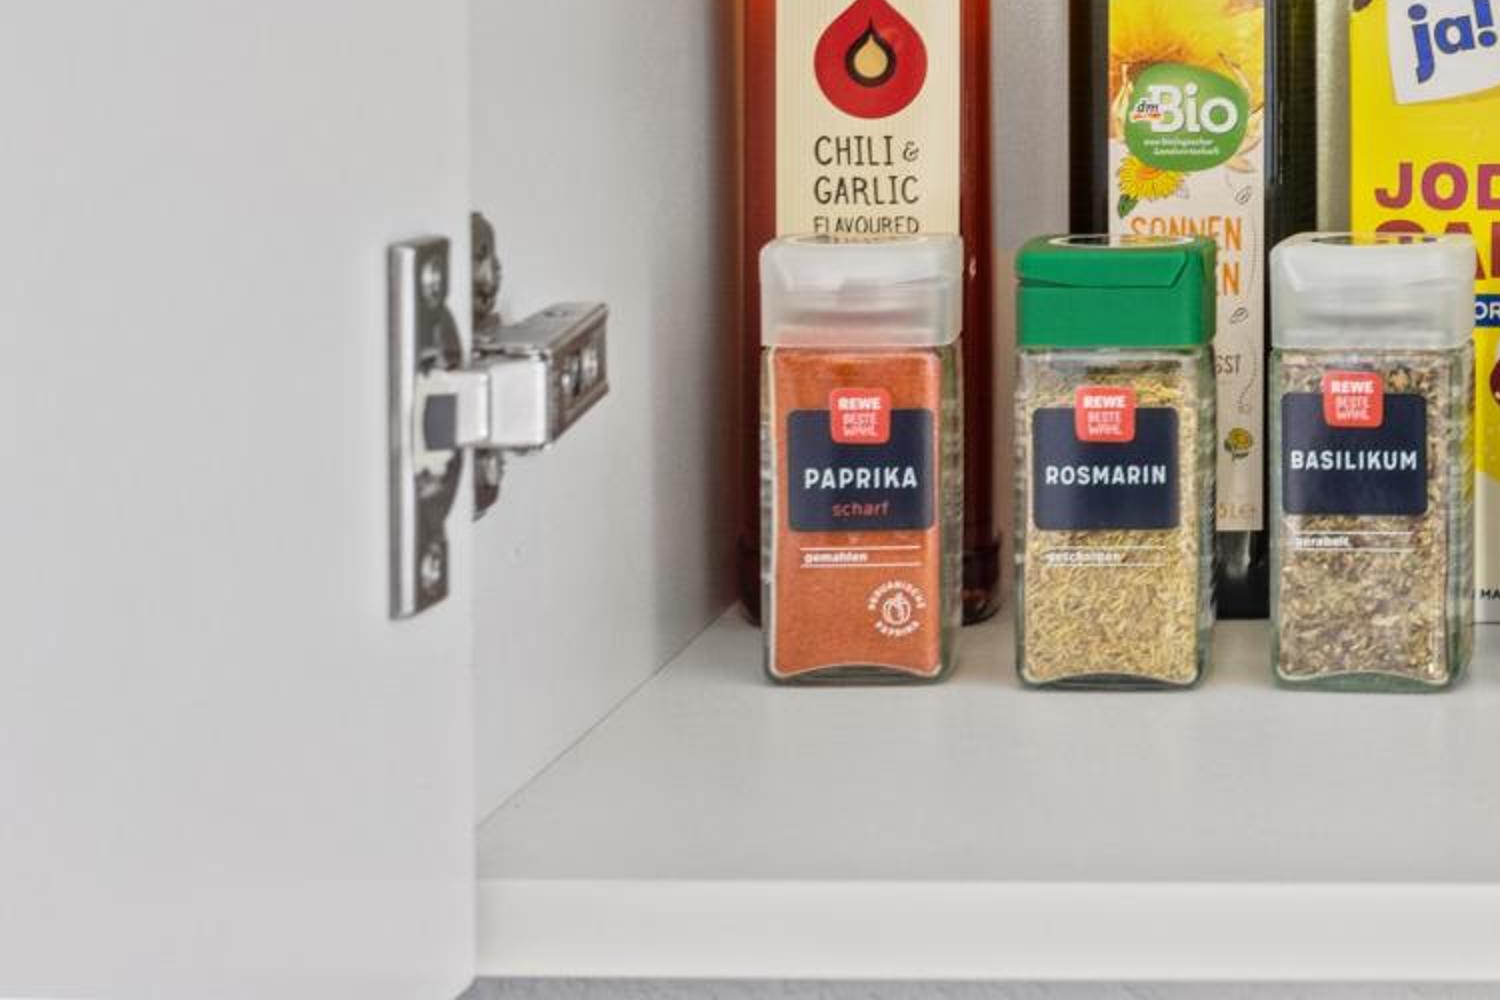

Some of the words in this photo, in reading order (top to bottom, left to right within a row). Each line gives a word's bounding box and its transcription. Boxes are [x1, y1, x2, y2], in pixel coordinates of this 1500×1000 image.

[1149, 82, 1239, 134] Bio
[814, 135, 894, 166] CHILI
[902, 140, 920, 162] &
[814, 175, 920, 206] GARLIC
[1331, 380, 1375, 394] REWE
[837, 396, 882, 410] REWE
[1083, 395, 1127, 409] REWE
[1290, 449, 1418, 471] BASILIKUM
[803, 466, 919, 489] PAPRIKA
[1045, 465, 1167, 486] ROSMARIN
[831, 501, 889, 518] scharf
[803, 550, 869, 566] gemahlen
